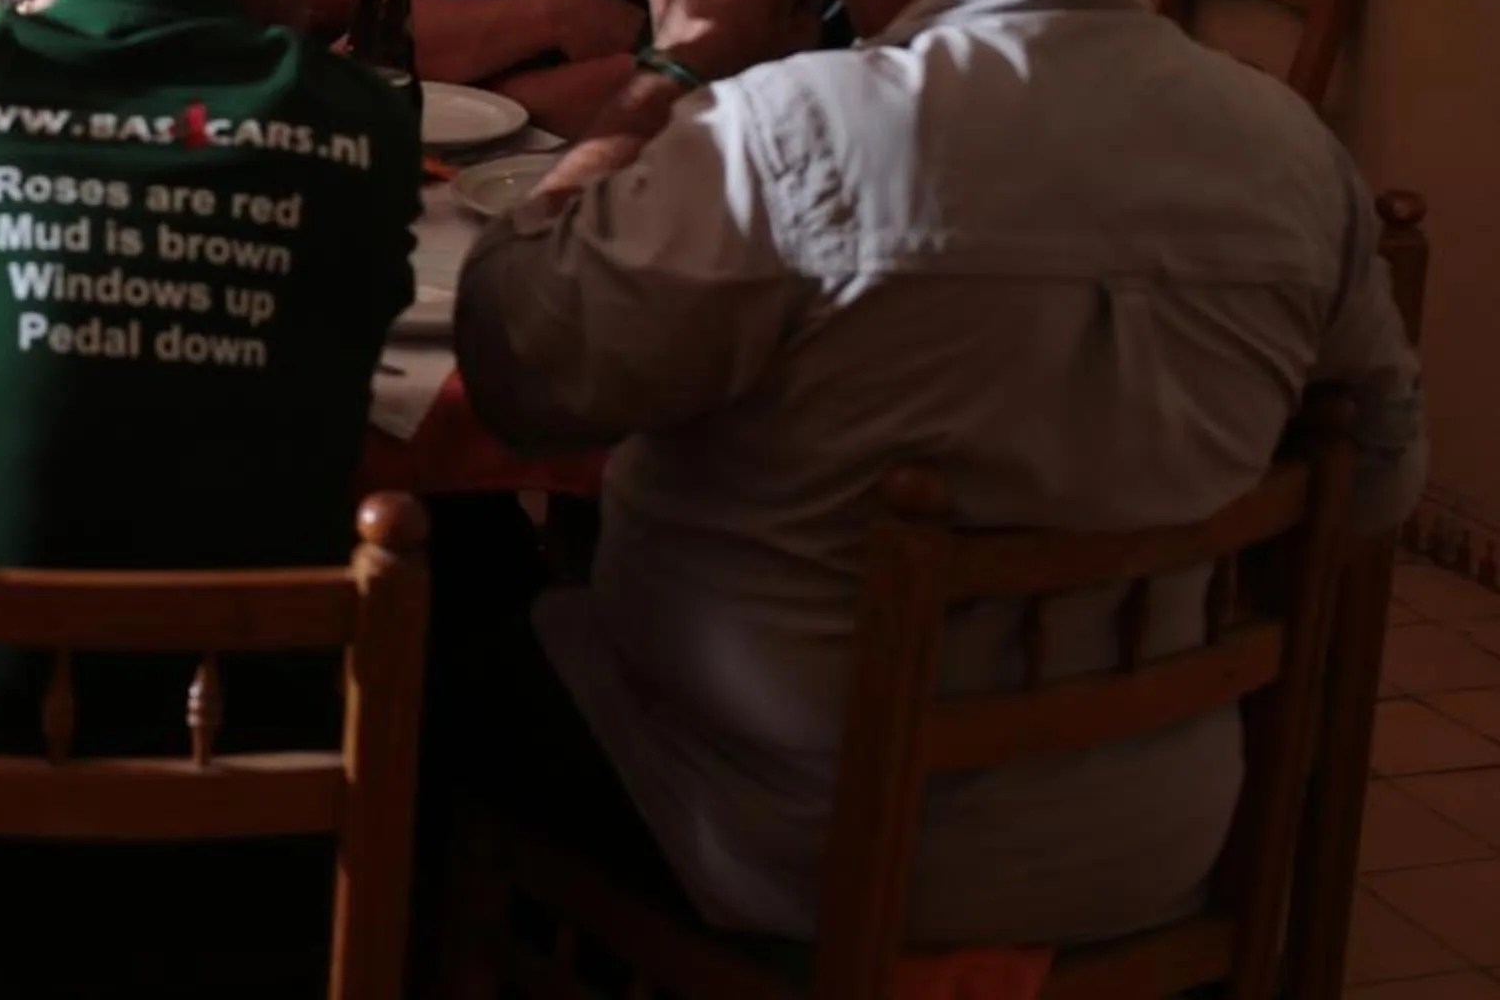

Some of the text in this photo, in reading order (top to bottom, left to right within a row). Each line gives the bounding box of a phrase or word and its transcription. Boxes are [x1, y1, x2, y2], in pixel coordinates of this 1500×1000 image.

[145, 183, 217, 217] are
[231, 191, 303, 230] red
[105, 217, 145, 258] is
[157, 221, 293, 276] brown
[7, 260, 277, 328] Windows up
[18, 311, 269, 368] Pedal down
